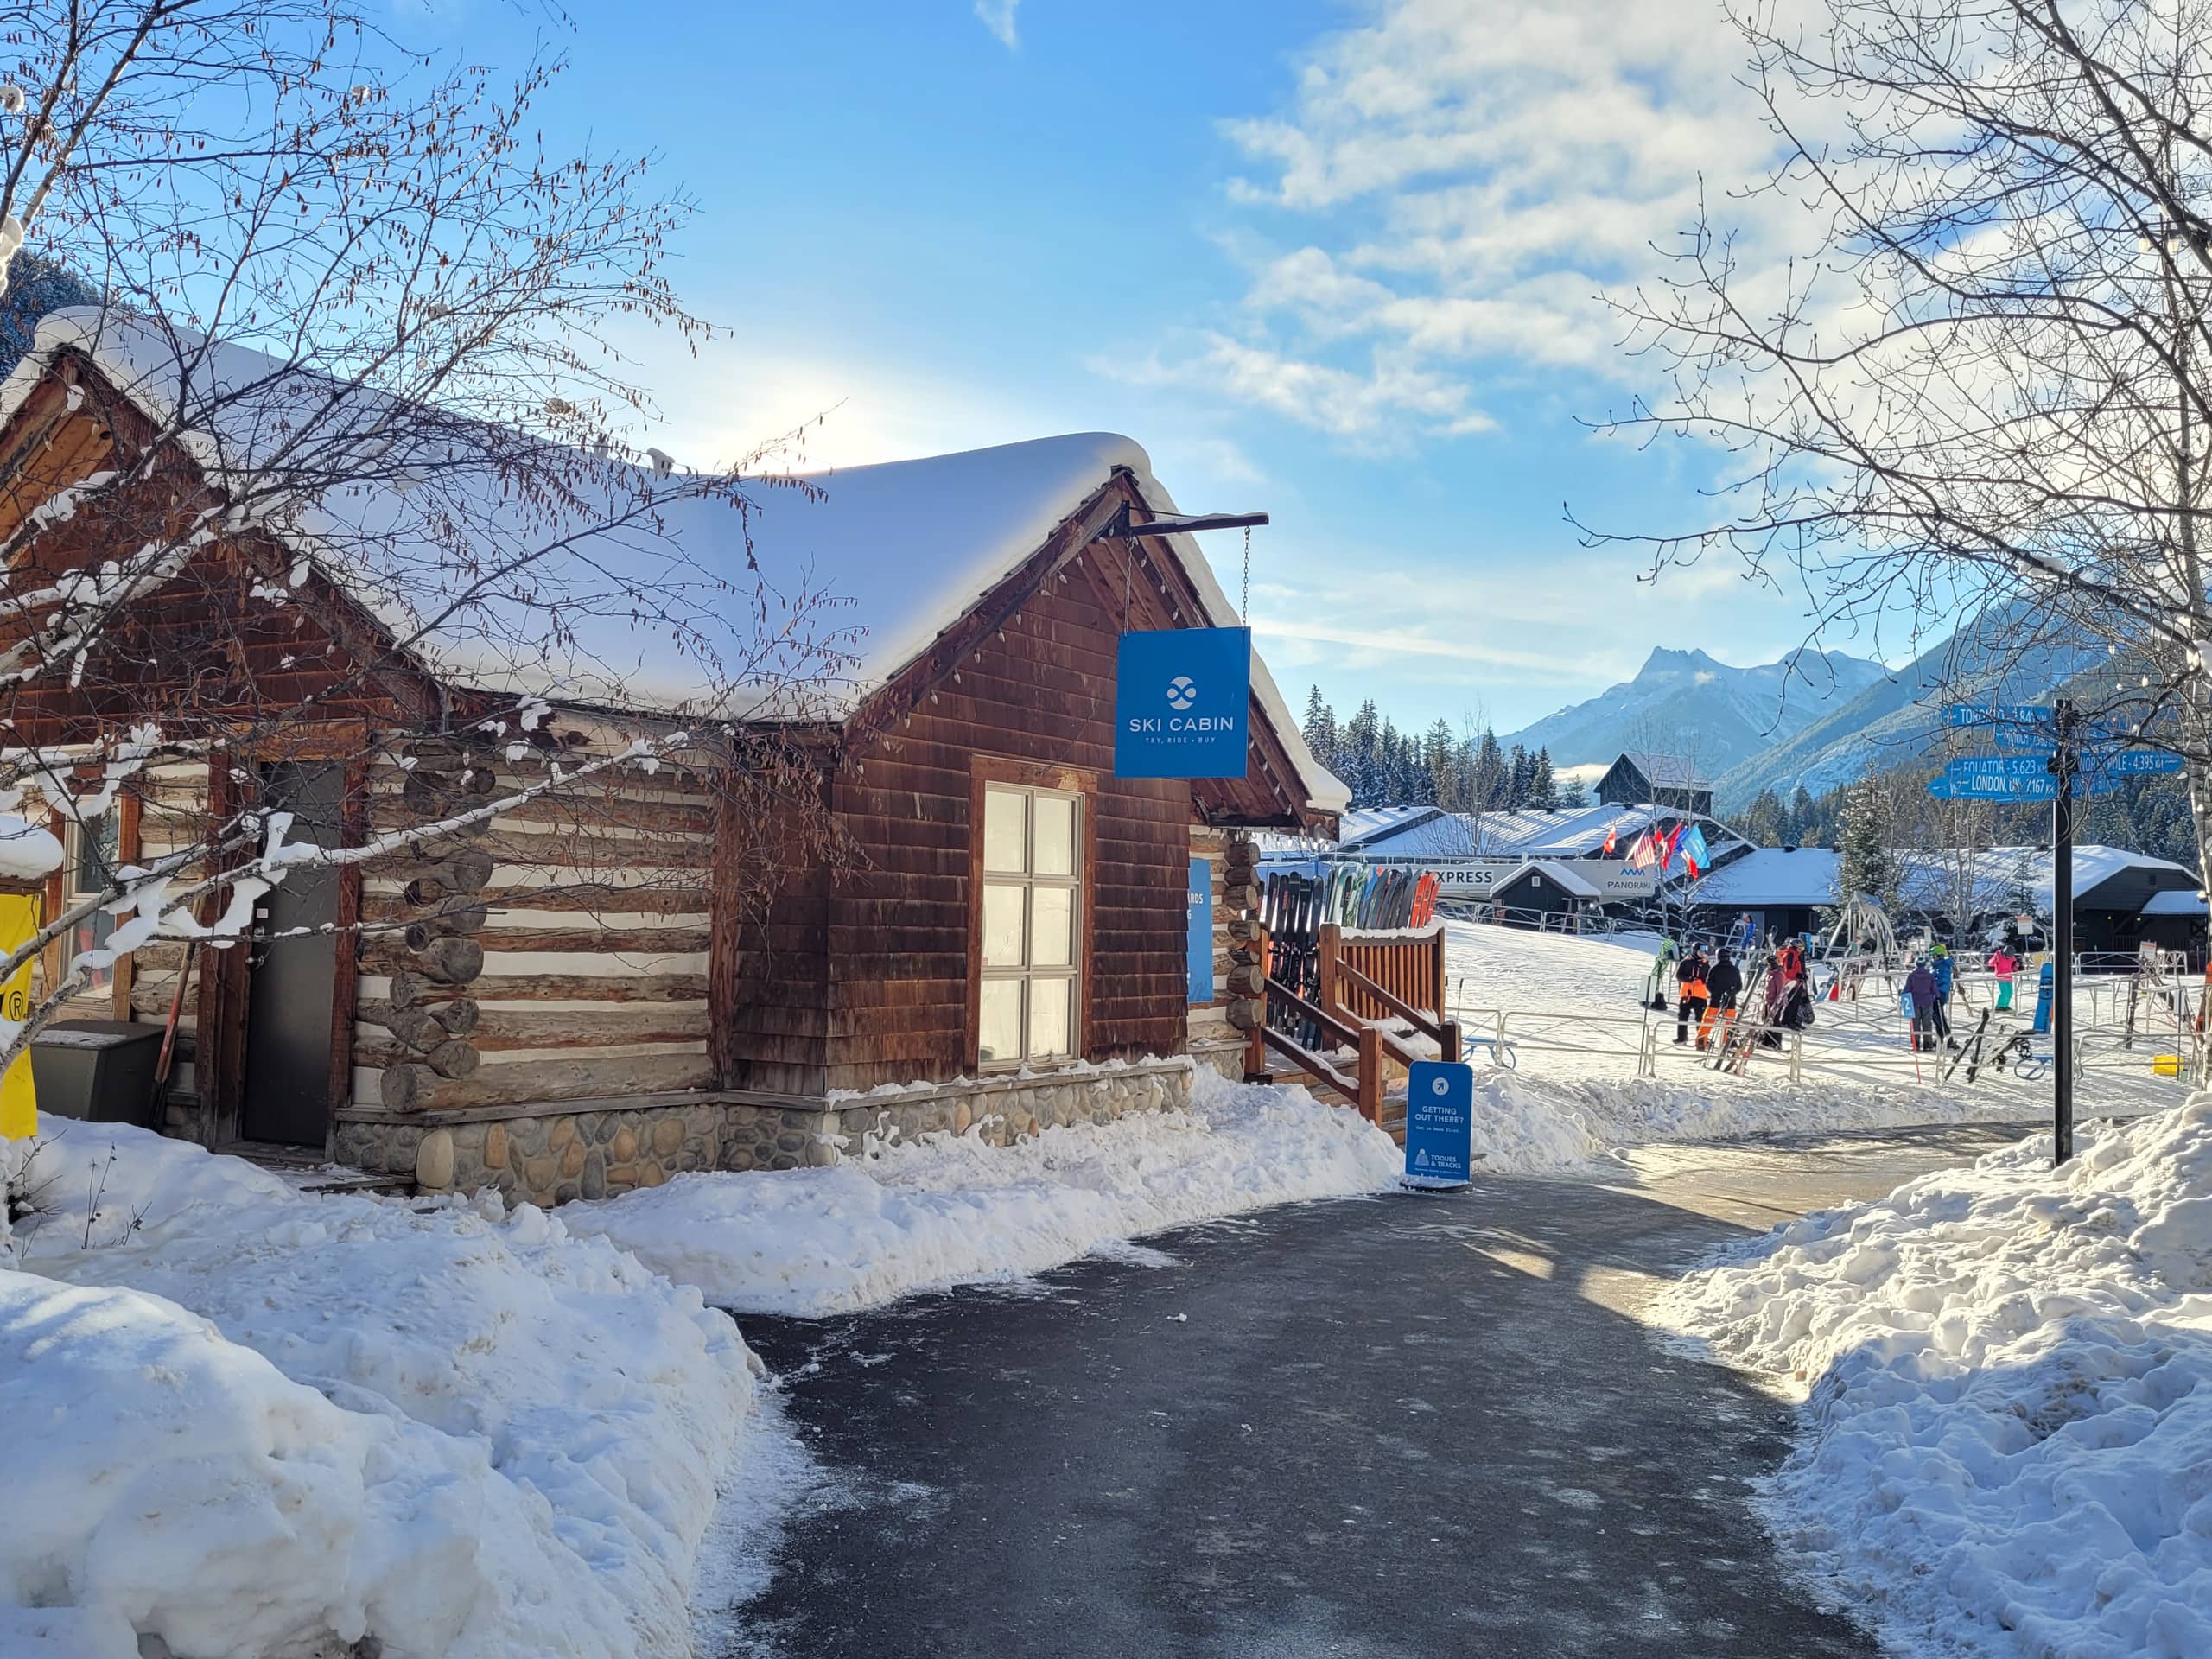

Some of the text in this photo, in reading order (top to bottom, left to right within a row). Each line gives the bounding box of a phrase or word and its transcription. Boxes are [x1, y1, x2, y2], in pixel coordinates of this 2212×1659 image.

[1960, 709, 2005, 724] TORONO
[1128, 716, 1234, 733] SKI CABIN
[2080, 756, 2107, 772] NOR
[2133, 755, 2154, 772] 4,395
[1971, 775, 2007, 793] LONDON,
[2026, 779, 2045, 795] 7,167
[1428, 871, 1493, 883] XPRESS
[1422, 1105, 1458, 1115] GETTING
[1414, 1113, 1465, 1124] OUT THERE?
[1430, 1154, 1457, 1163] TOQUES
